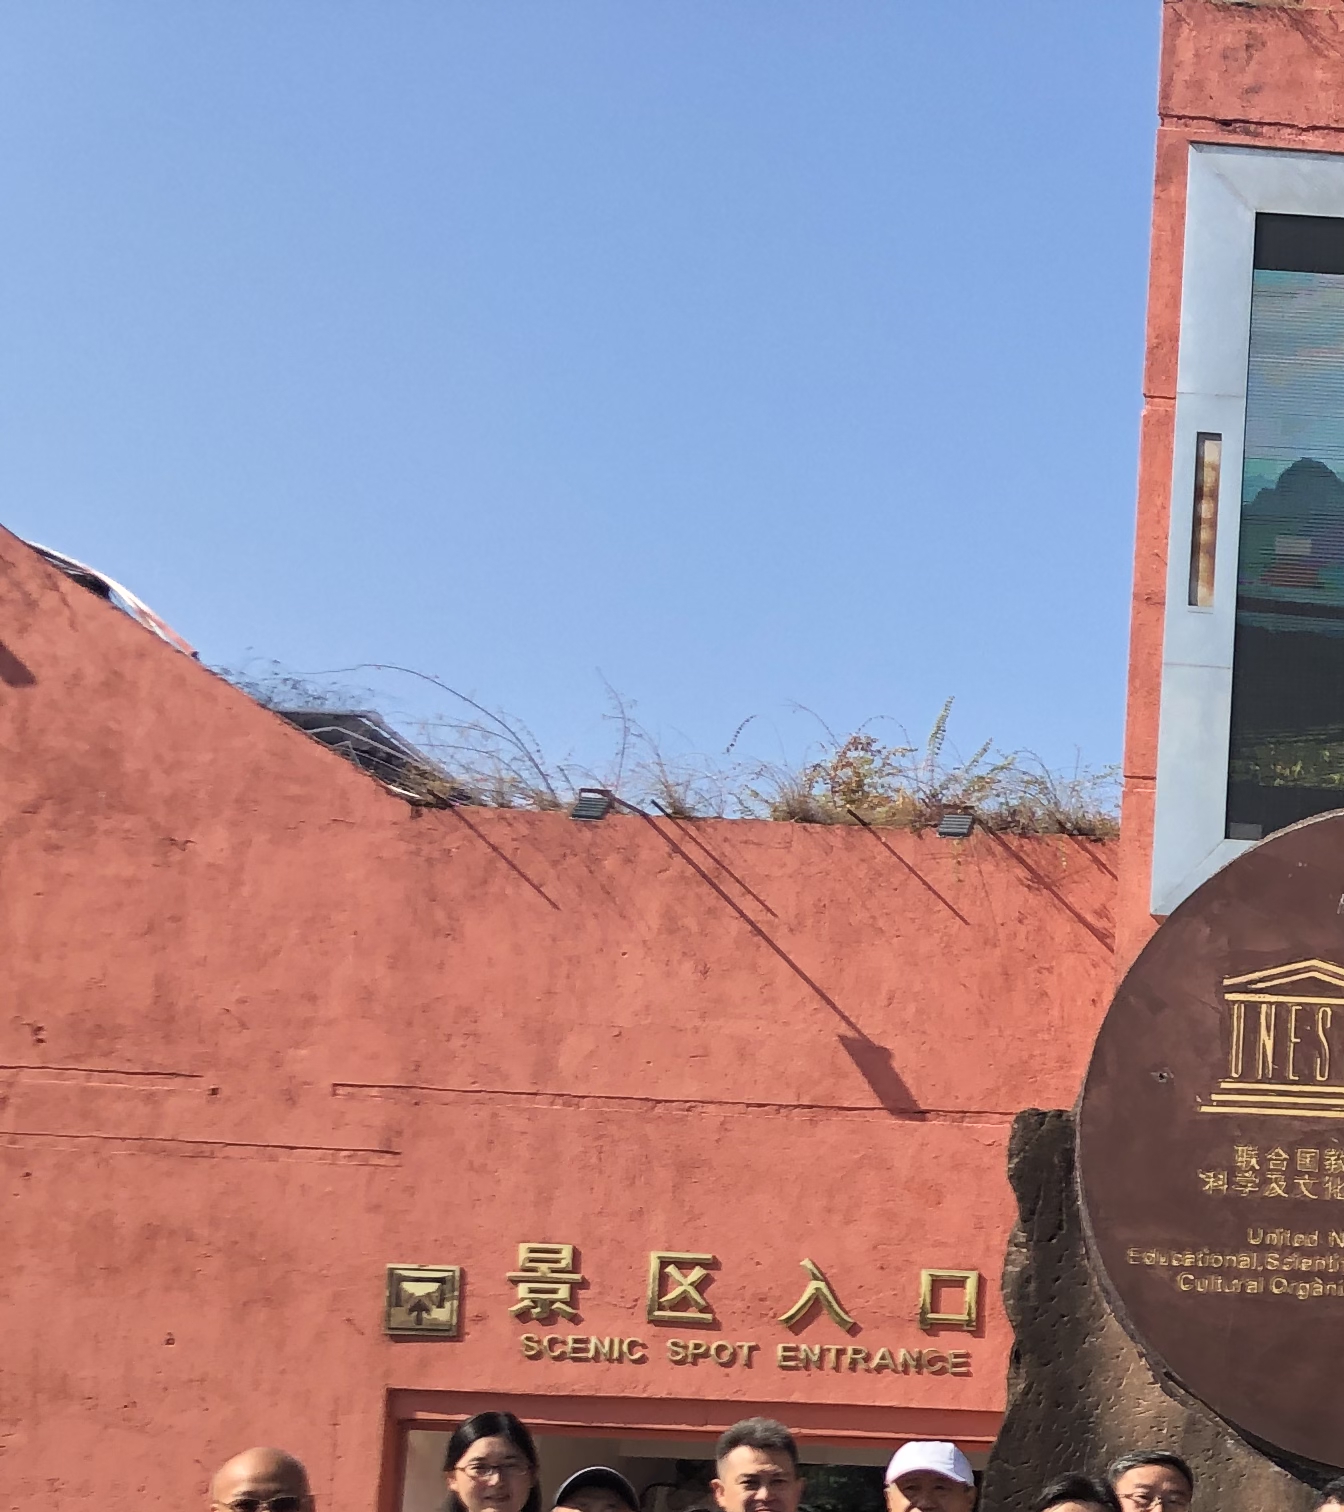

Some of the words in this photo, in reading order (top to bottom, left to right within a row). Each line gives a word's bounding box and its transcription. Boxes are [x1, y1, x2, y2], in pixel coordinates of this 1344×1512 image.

[1247, 1228, 1320, 1247] United
[506, 1242, 981, 1334] 景区入口
[1177, 1271, 1264, 1294] Cultural
[519, 1333, 647, 1365] SCENIC
[666, 1337, 759, 1369] SPOT
[777, 1342, 974, 1377] ENTRANCE
